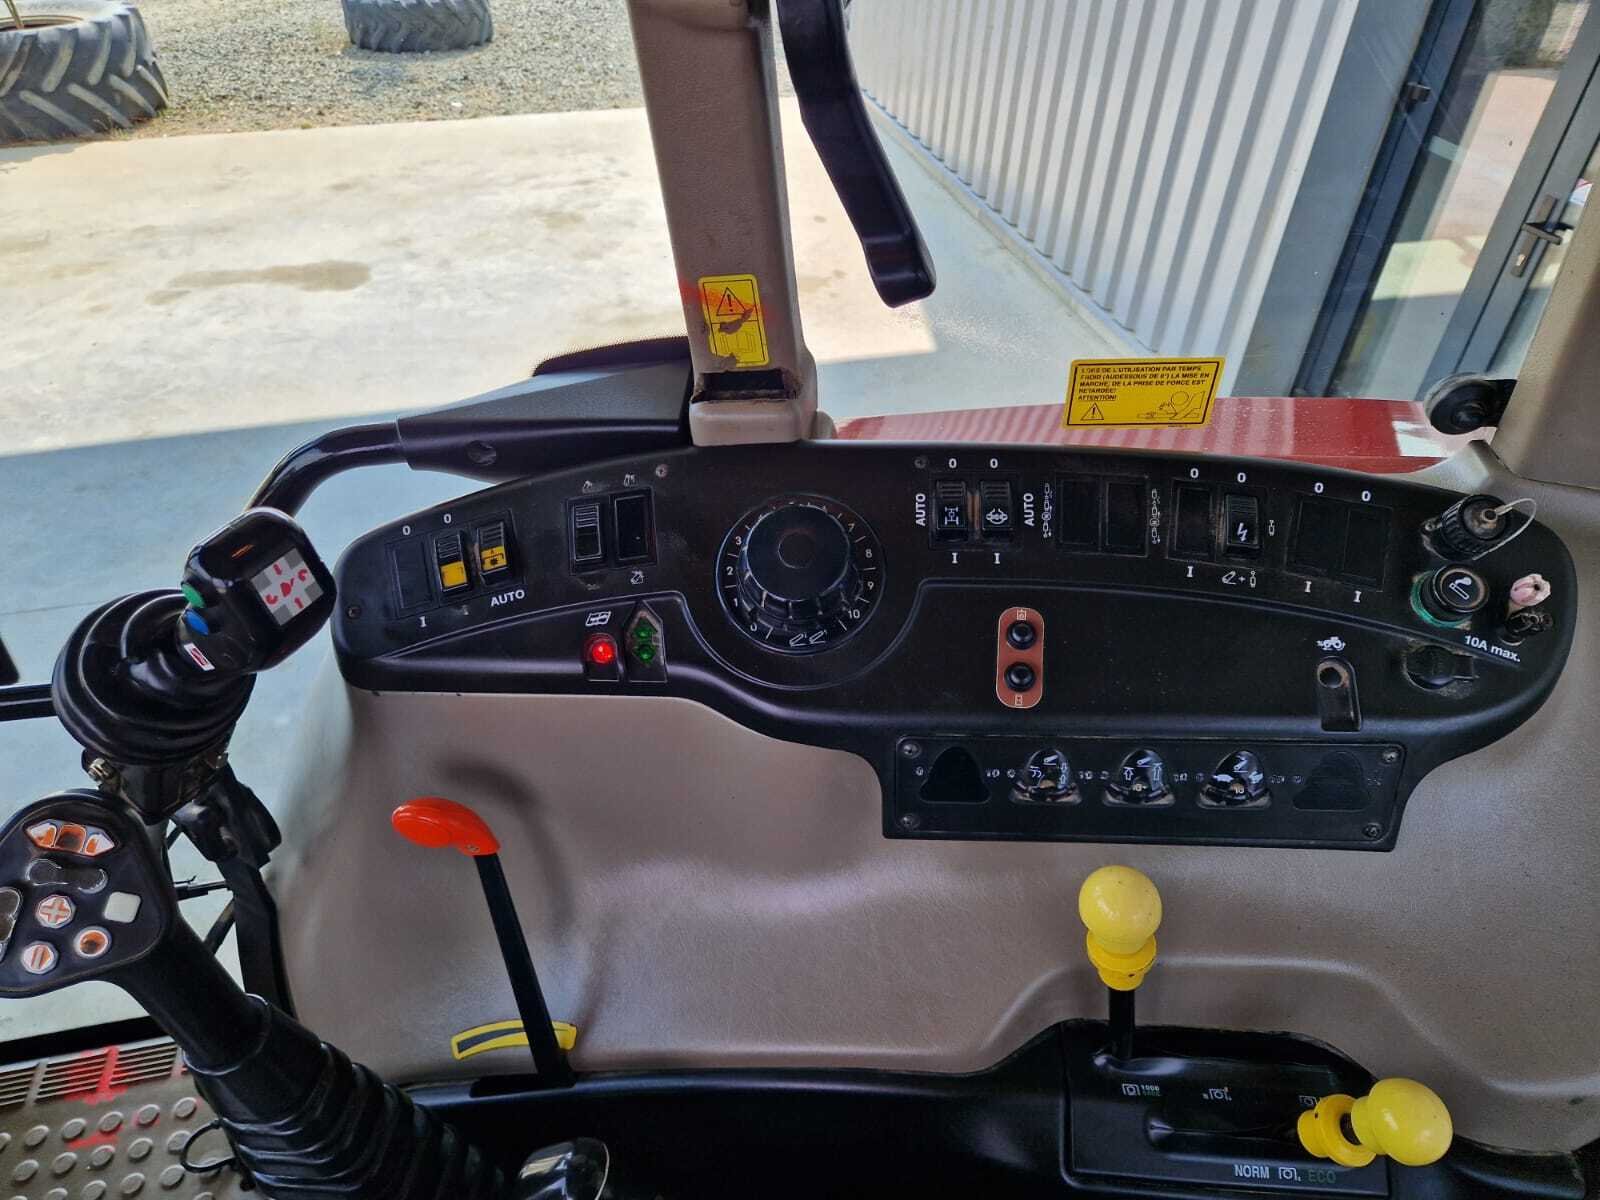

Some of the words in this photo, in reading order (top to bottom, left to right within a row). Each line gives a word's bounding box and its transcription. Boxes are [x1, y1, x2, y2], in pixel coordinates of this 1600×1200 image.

[948, 458, 957, 469] 0
[990, 458, 999, 469] 0
[1190, 468, 1199, 479] 0
[1237, 473, 1247, 483] 0
[1314, 482, 1324, 494] 0
[1361, 491, 1371, 501] 0
[915, 493, 927, 526] AUTO
[1023, 492, 1035, 526] AUTO
[444, 513, 453, 524] 0
[402, 525, 412, 536] 0
[735, 536, 742, 545] 3
[865, 548, 873, 558] 8
[726, 566, 734, 575] 2
[867, 581, 874, 590] 9
[490, 588, 526, 607] AUTO
[848, 609, 861, 619] 10
[1464, 634, 1488, 651] 10A
[1491, 644, 1521, 663] max.
[1234, 1164, 1270, 1179] NORM
[1307, 1168, 1337, 1184] ECO
